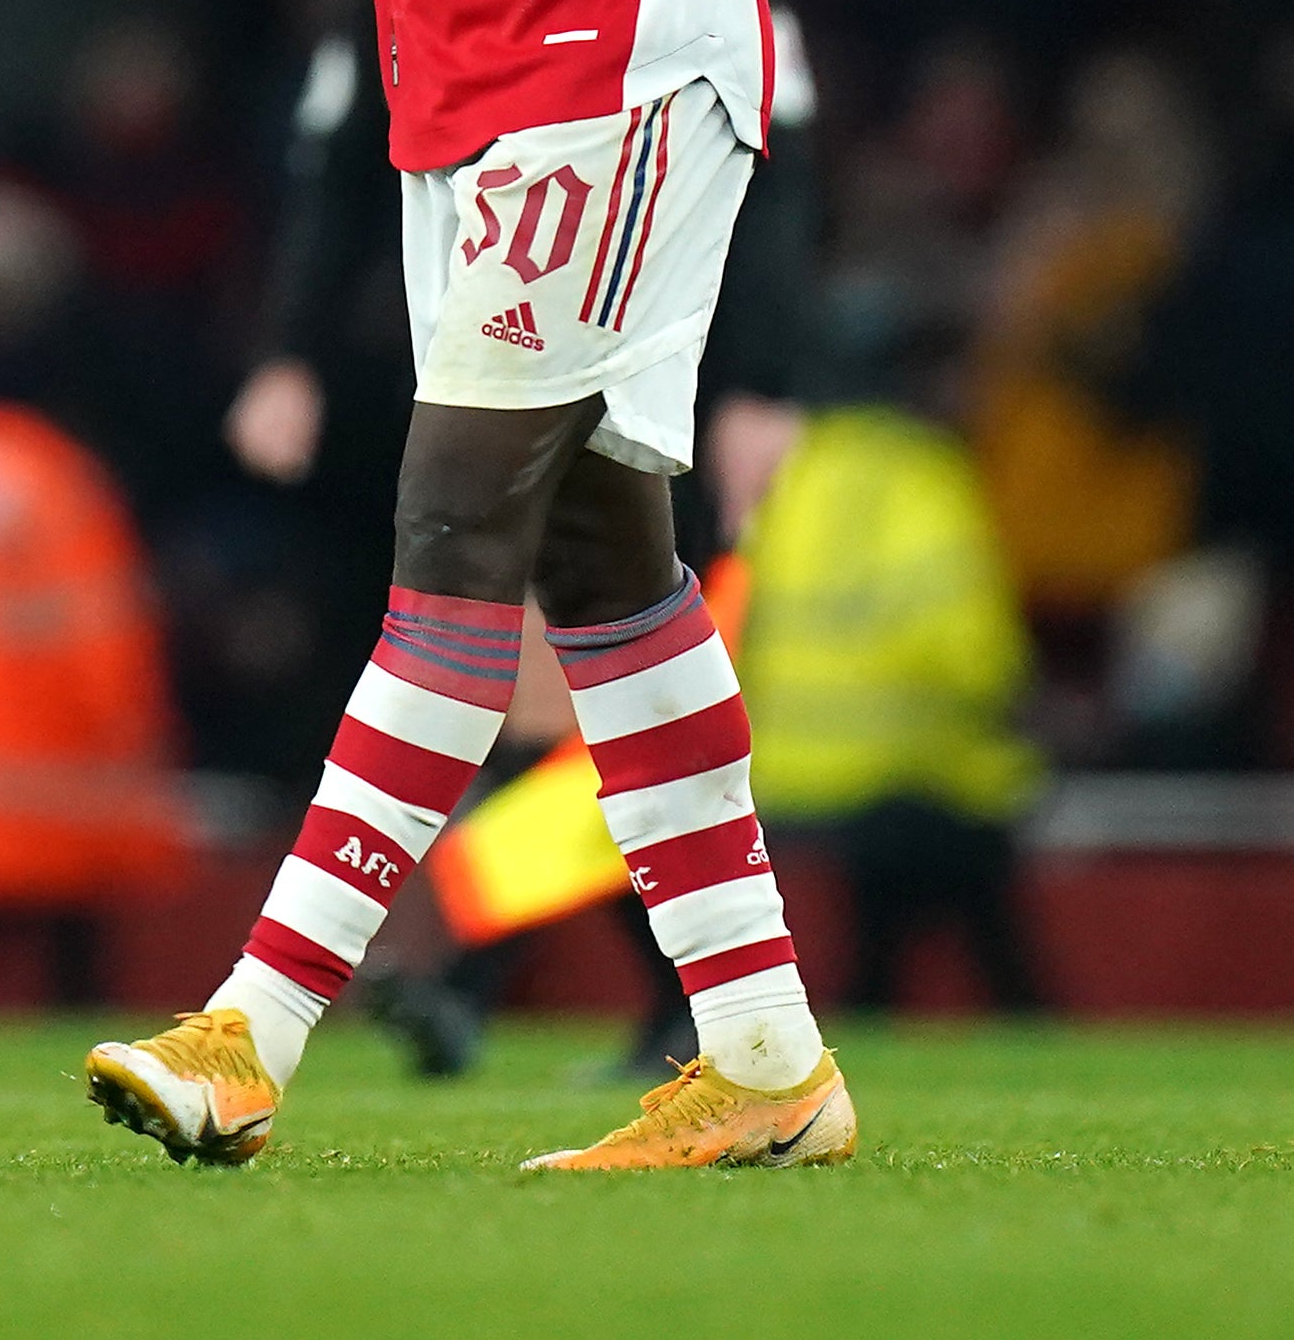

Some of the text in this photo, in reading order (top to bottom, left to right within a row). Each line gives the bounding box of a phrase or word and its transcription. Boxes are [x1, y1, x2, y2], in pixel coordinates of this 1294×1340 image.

[461, 163, 595, 285] 50
[482, 321, 545, 352] adidas
[333, 836, 400, 887] AFC
